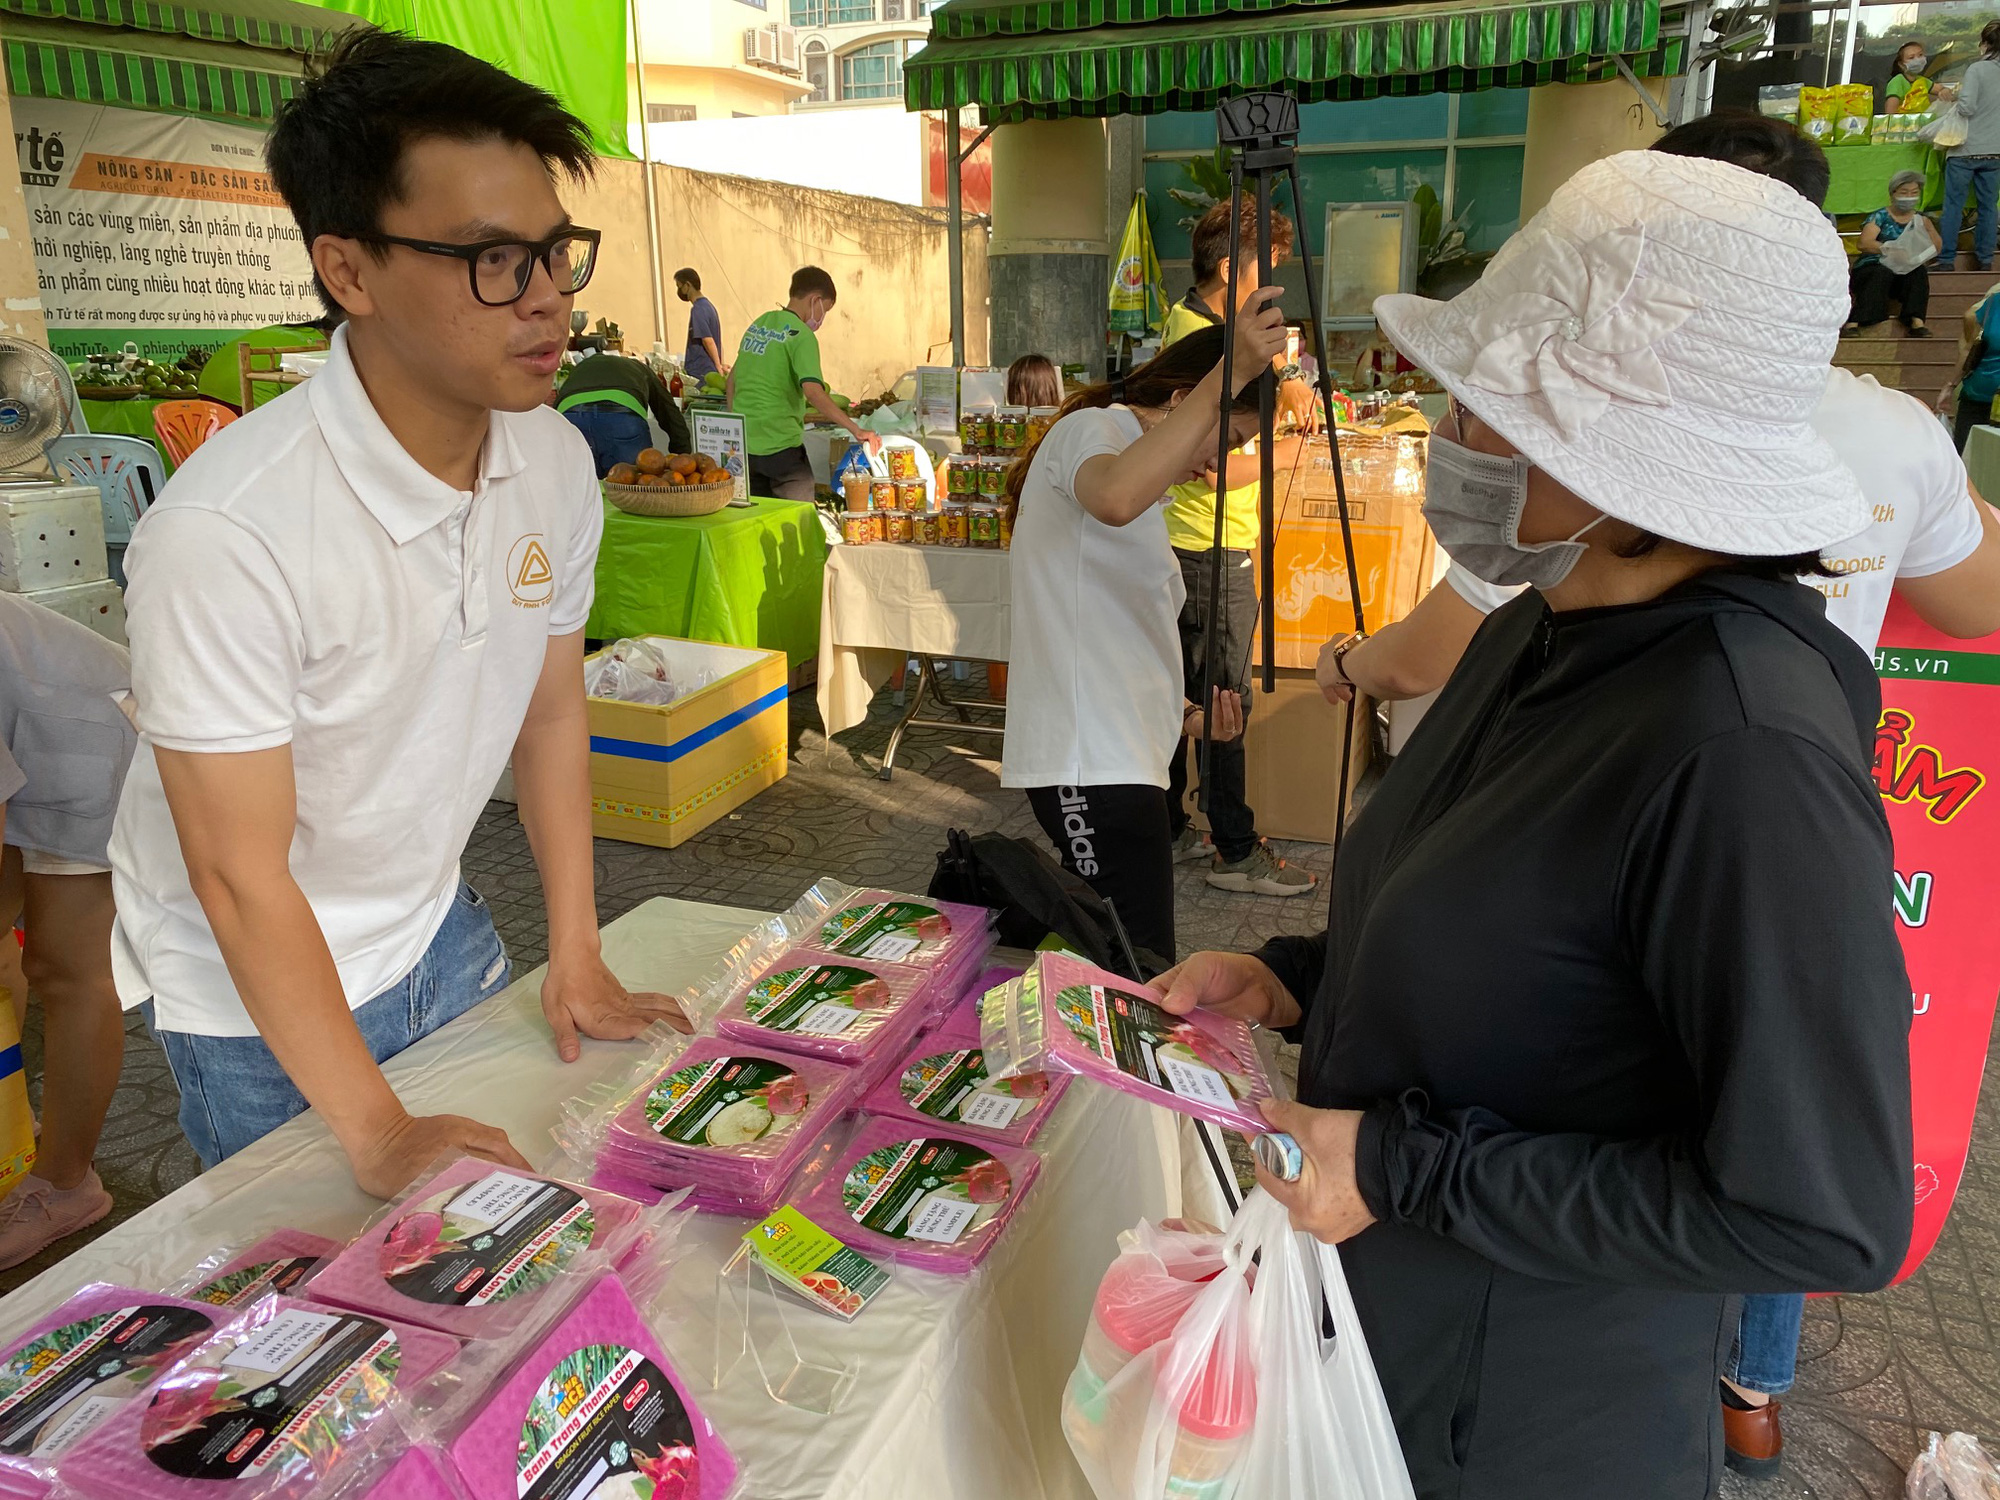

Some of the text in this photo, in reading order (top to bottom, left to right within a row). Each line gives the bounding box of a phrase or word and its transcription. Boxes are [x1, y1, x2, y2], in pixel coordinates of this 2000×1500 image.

[97, 159, 138, 179] NÔNG
[145, 162, 173, 182] SẢN
[191, 169, 216, 189] ĐẶC
[222, 171, 248, 190] SẢN
[100, 181, 171, 195] AGRICULTURAL
[181, 189, 233, 201] SPECIALTIES
[236, 193, 259, 203] FROM
[34, 203, 302, 243] sản các vùng miền, sản phẩm địa phươn
[32, 236, 271, 271] hởi nghiệp, làng nghề truyền thống
[38, 269, 56, 290] ản
[61, 268, 101, 294] phẩm
[106, 273, 140, 296] cùng
[143, 272, 179, 293] nhiều
[182, 276, 212, 297] hoạt
[215, 277, 245, 298] động
[248, 278, 276, 296] khác
[279, 280, 294, 299] tại
[56, 307, 72, 320] Tử
[75, 308, 86, 320] tế
[88, 308, 103, 320] rất
[106, 311, 136, 323] mong
[139, 309, 165, 323] được
[168, 311, 181, 324] sự
[183, 309, 200, 323] ủng
[204, 310, 215, 322] hộ
[218, 310, 228, 321] và
[231, 311, 253, 324] phục
[256, 313, 266, 322] vụ
[268, 312, 284, 324] quý
[286, 312, 312, 322] khách
[1874, 651, 1949, 675] ds.vn
[1057, 785, 1099, 877] didas
[504, 1248, 537, 1274] Thanh
[478, 1276, 506, 1299] Long
[55, 1339, 95, 1366] Thanh
[94, 1315, 126, 1336] Long
[557, 1381, 586, 1419] RICE
[523, 1449, 552, 1484] Banh
[550, 1416, 581, 1451] Trang
[579, 1383, 610, 1418] Thanh
[609, 1358, 634, 1386] Long
[253, 1437, 289, 1468] Long
